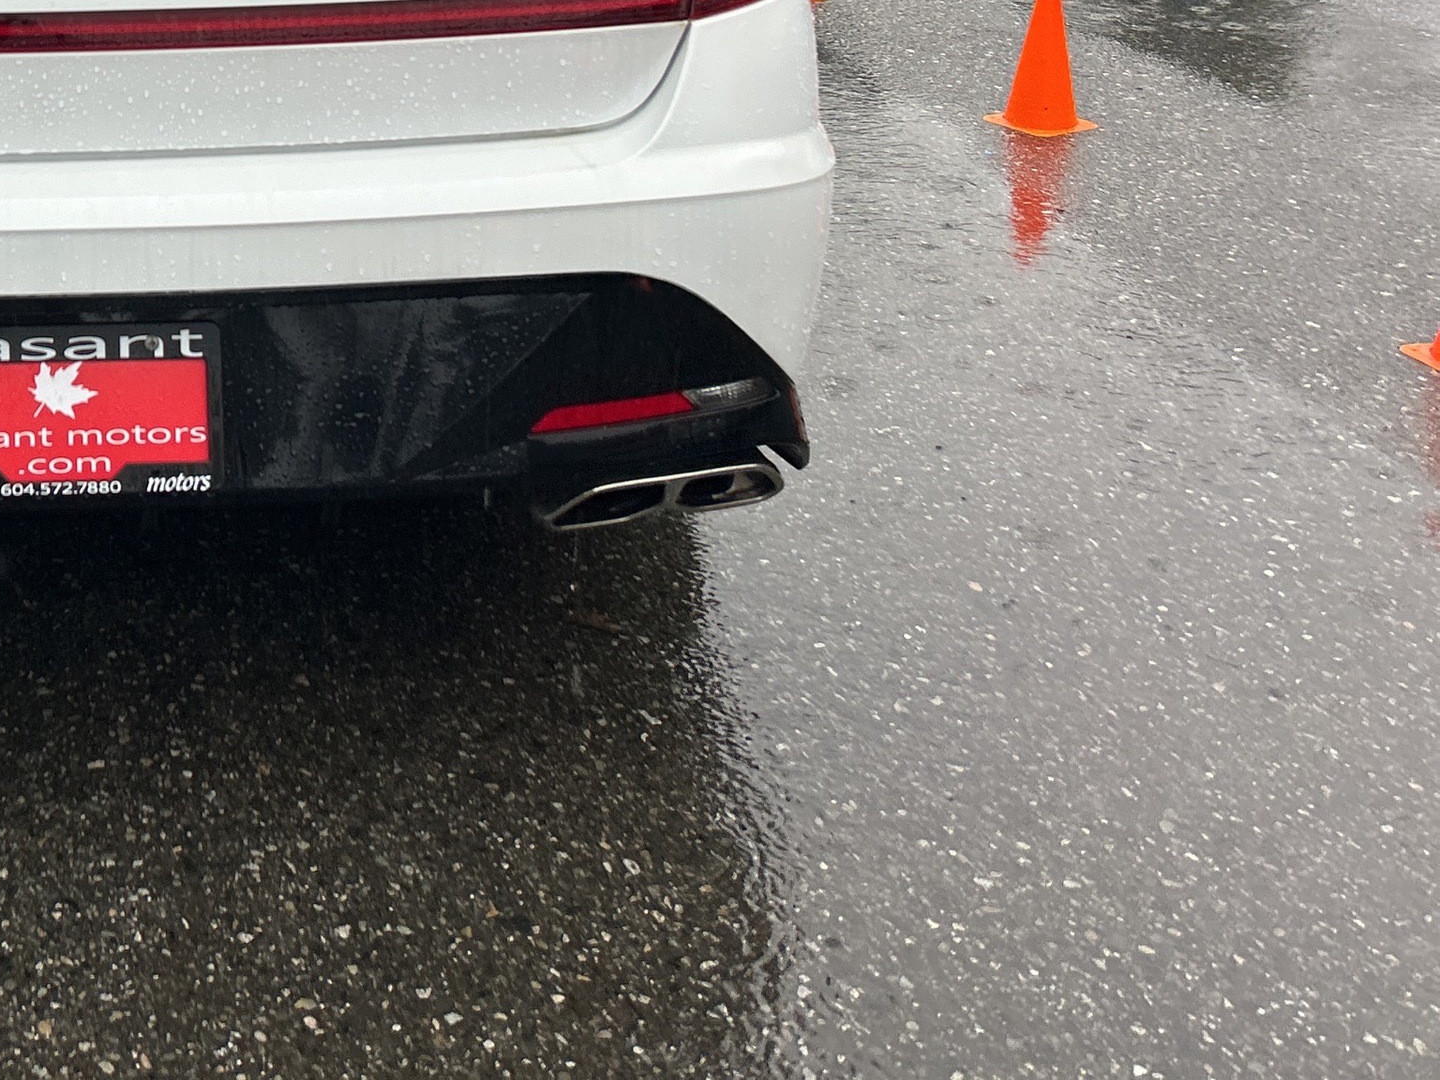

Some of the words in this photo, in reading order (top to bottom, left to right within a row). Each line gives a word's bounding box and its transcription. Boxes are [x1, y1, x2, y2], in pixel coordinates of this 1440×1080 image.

[67, 424, 208, 446] motors
[18, 456, 112, 476] .com
[0, 480, 122, 497] 604.572.7880
[146, 472, 212, 493] motors
